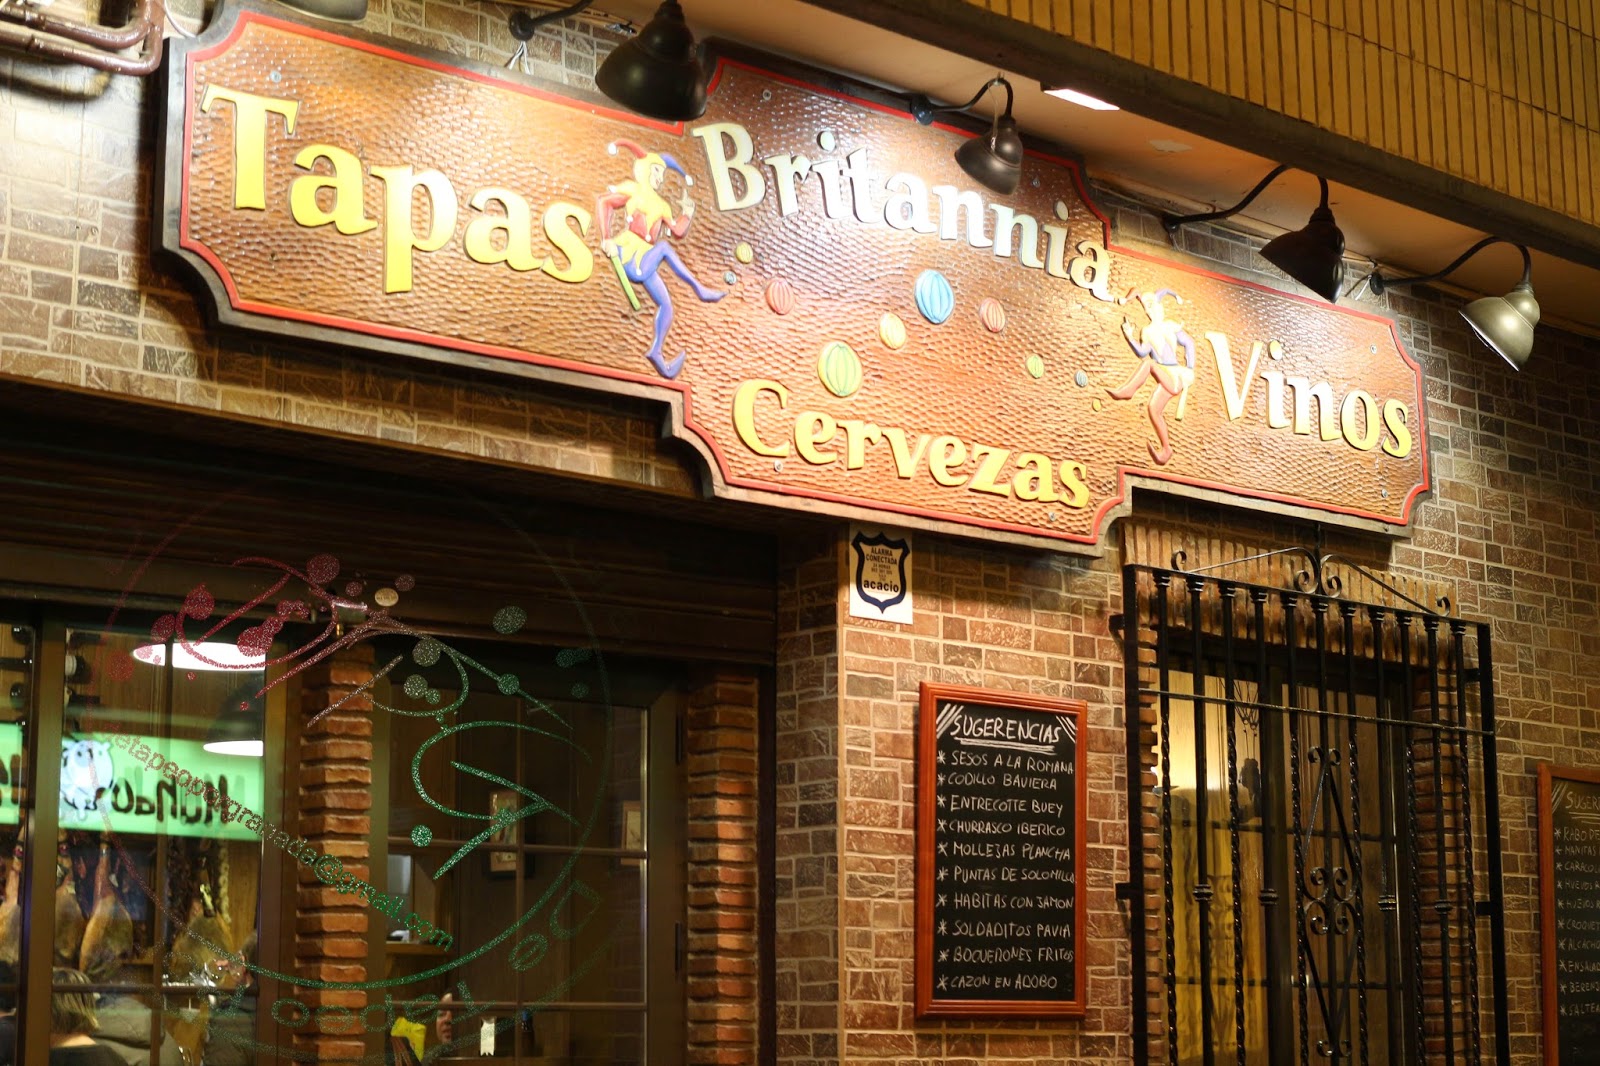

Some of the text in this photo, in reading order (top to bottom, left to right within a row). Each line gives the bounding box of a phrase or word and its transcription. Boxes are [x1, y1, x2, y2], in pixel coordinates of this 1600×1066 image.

[201, 83, 593, 294] Tapas
[691, 122, 1119, 303] Britannia
[1204, 331, 1413, 458] Vinos
[733, 379, 1091, 509] Cervezas
[865, 554, 898, 565] CONECTADA
[863, 580, 899, 593] acacio
[950, 715, 1061, 743] SUGERENCIAS
[951, 751, 1074, 775] SESOS A LA ROMANA
[947, 772, 1057, 790] CODILLO BAVIERA
[1031, 801, 1064, 818] BUEY
[949, 819, 1066, 836] CHURRASCO IBERICO
[1563, 827, 1587, 841] RABO
[953, 841, 1071, 861] MOLLEJAS PLANCHA
[954, 865, 996, 883] PUNTAS
[1001, 866, 1018, 882] DE
[955, 892, 1074, 910] HABITAS CON JAMON
[952, 920, 1071, 939] SOLDADITOS PAVIA
[953, 946, 1074, 963] BOQUERONES FRITOS
[951, 973, 1058, 990] CAZON EN ADOBO
